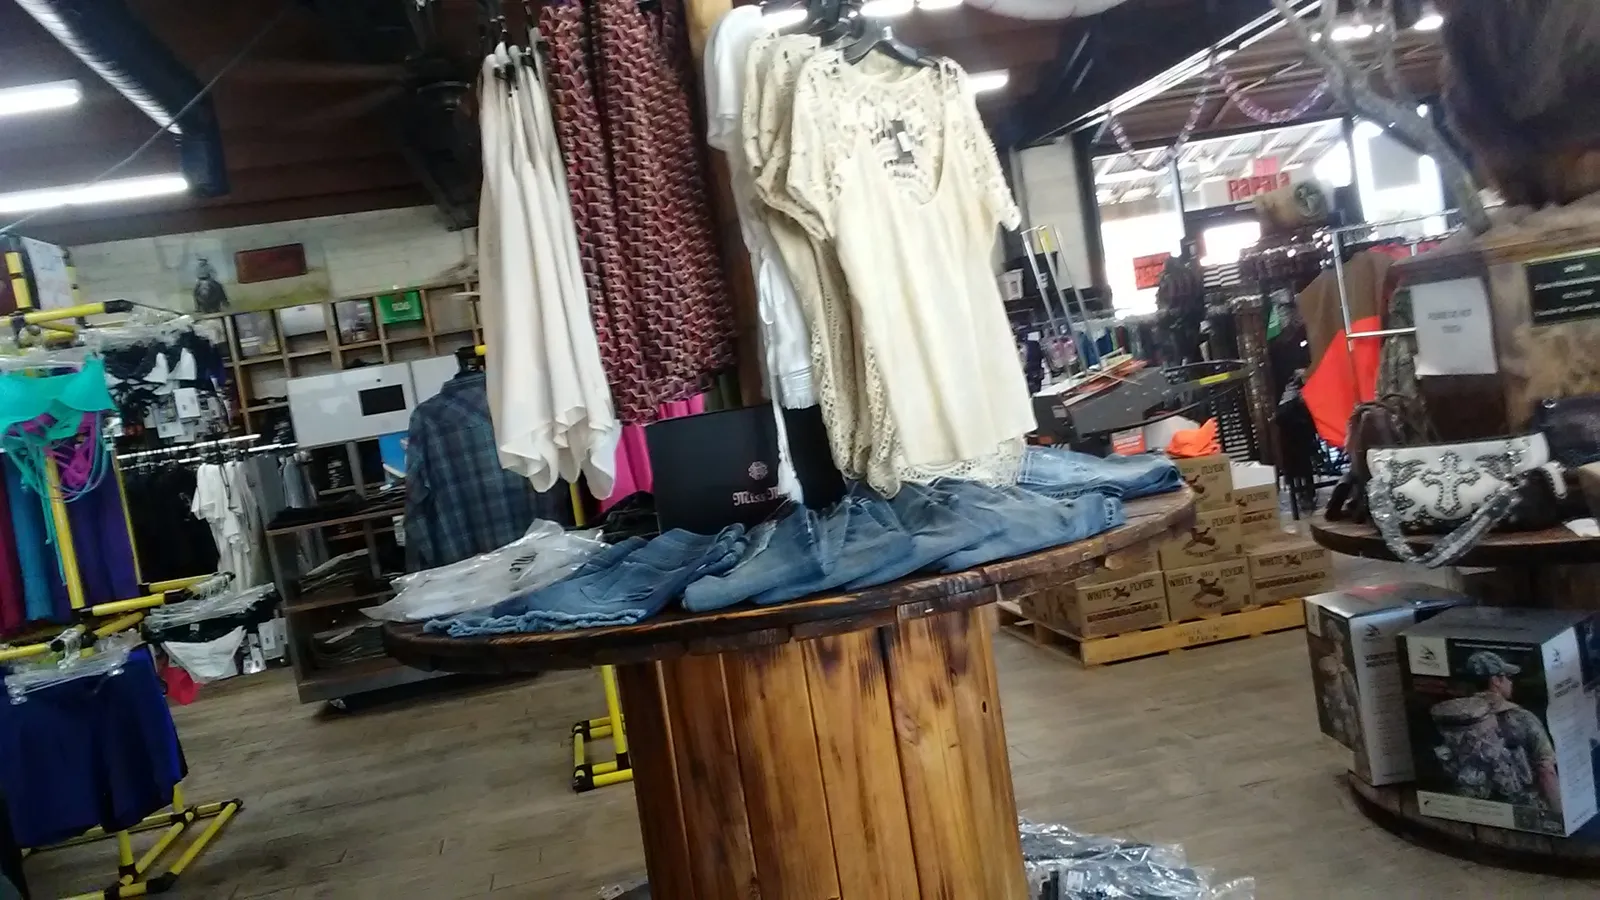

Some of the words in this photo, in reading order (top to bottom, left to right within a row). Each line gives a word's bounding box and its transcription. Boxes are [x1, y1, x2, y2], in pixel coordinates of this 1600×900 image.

[733, 491, 766, 506] Miss
[1221, 566, 1244, 578] FLYER
[1086, 588, 1112, 601] WHITE
[1129, 579, 1154, 592] FLYER
